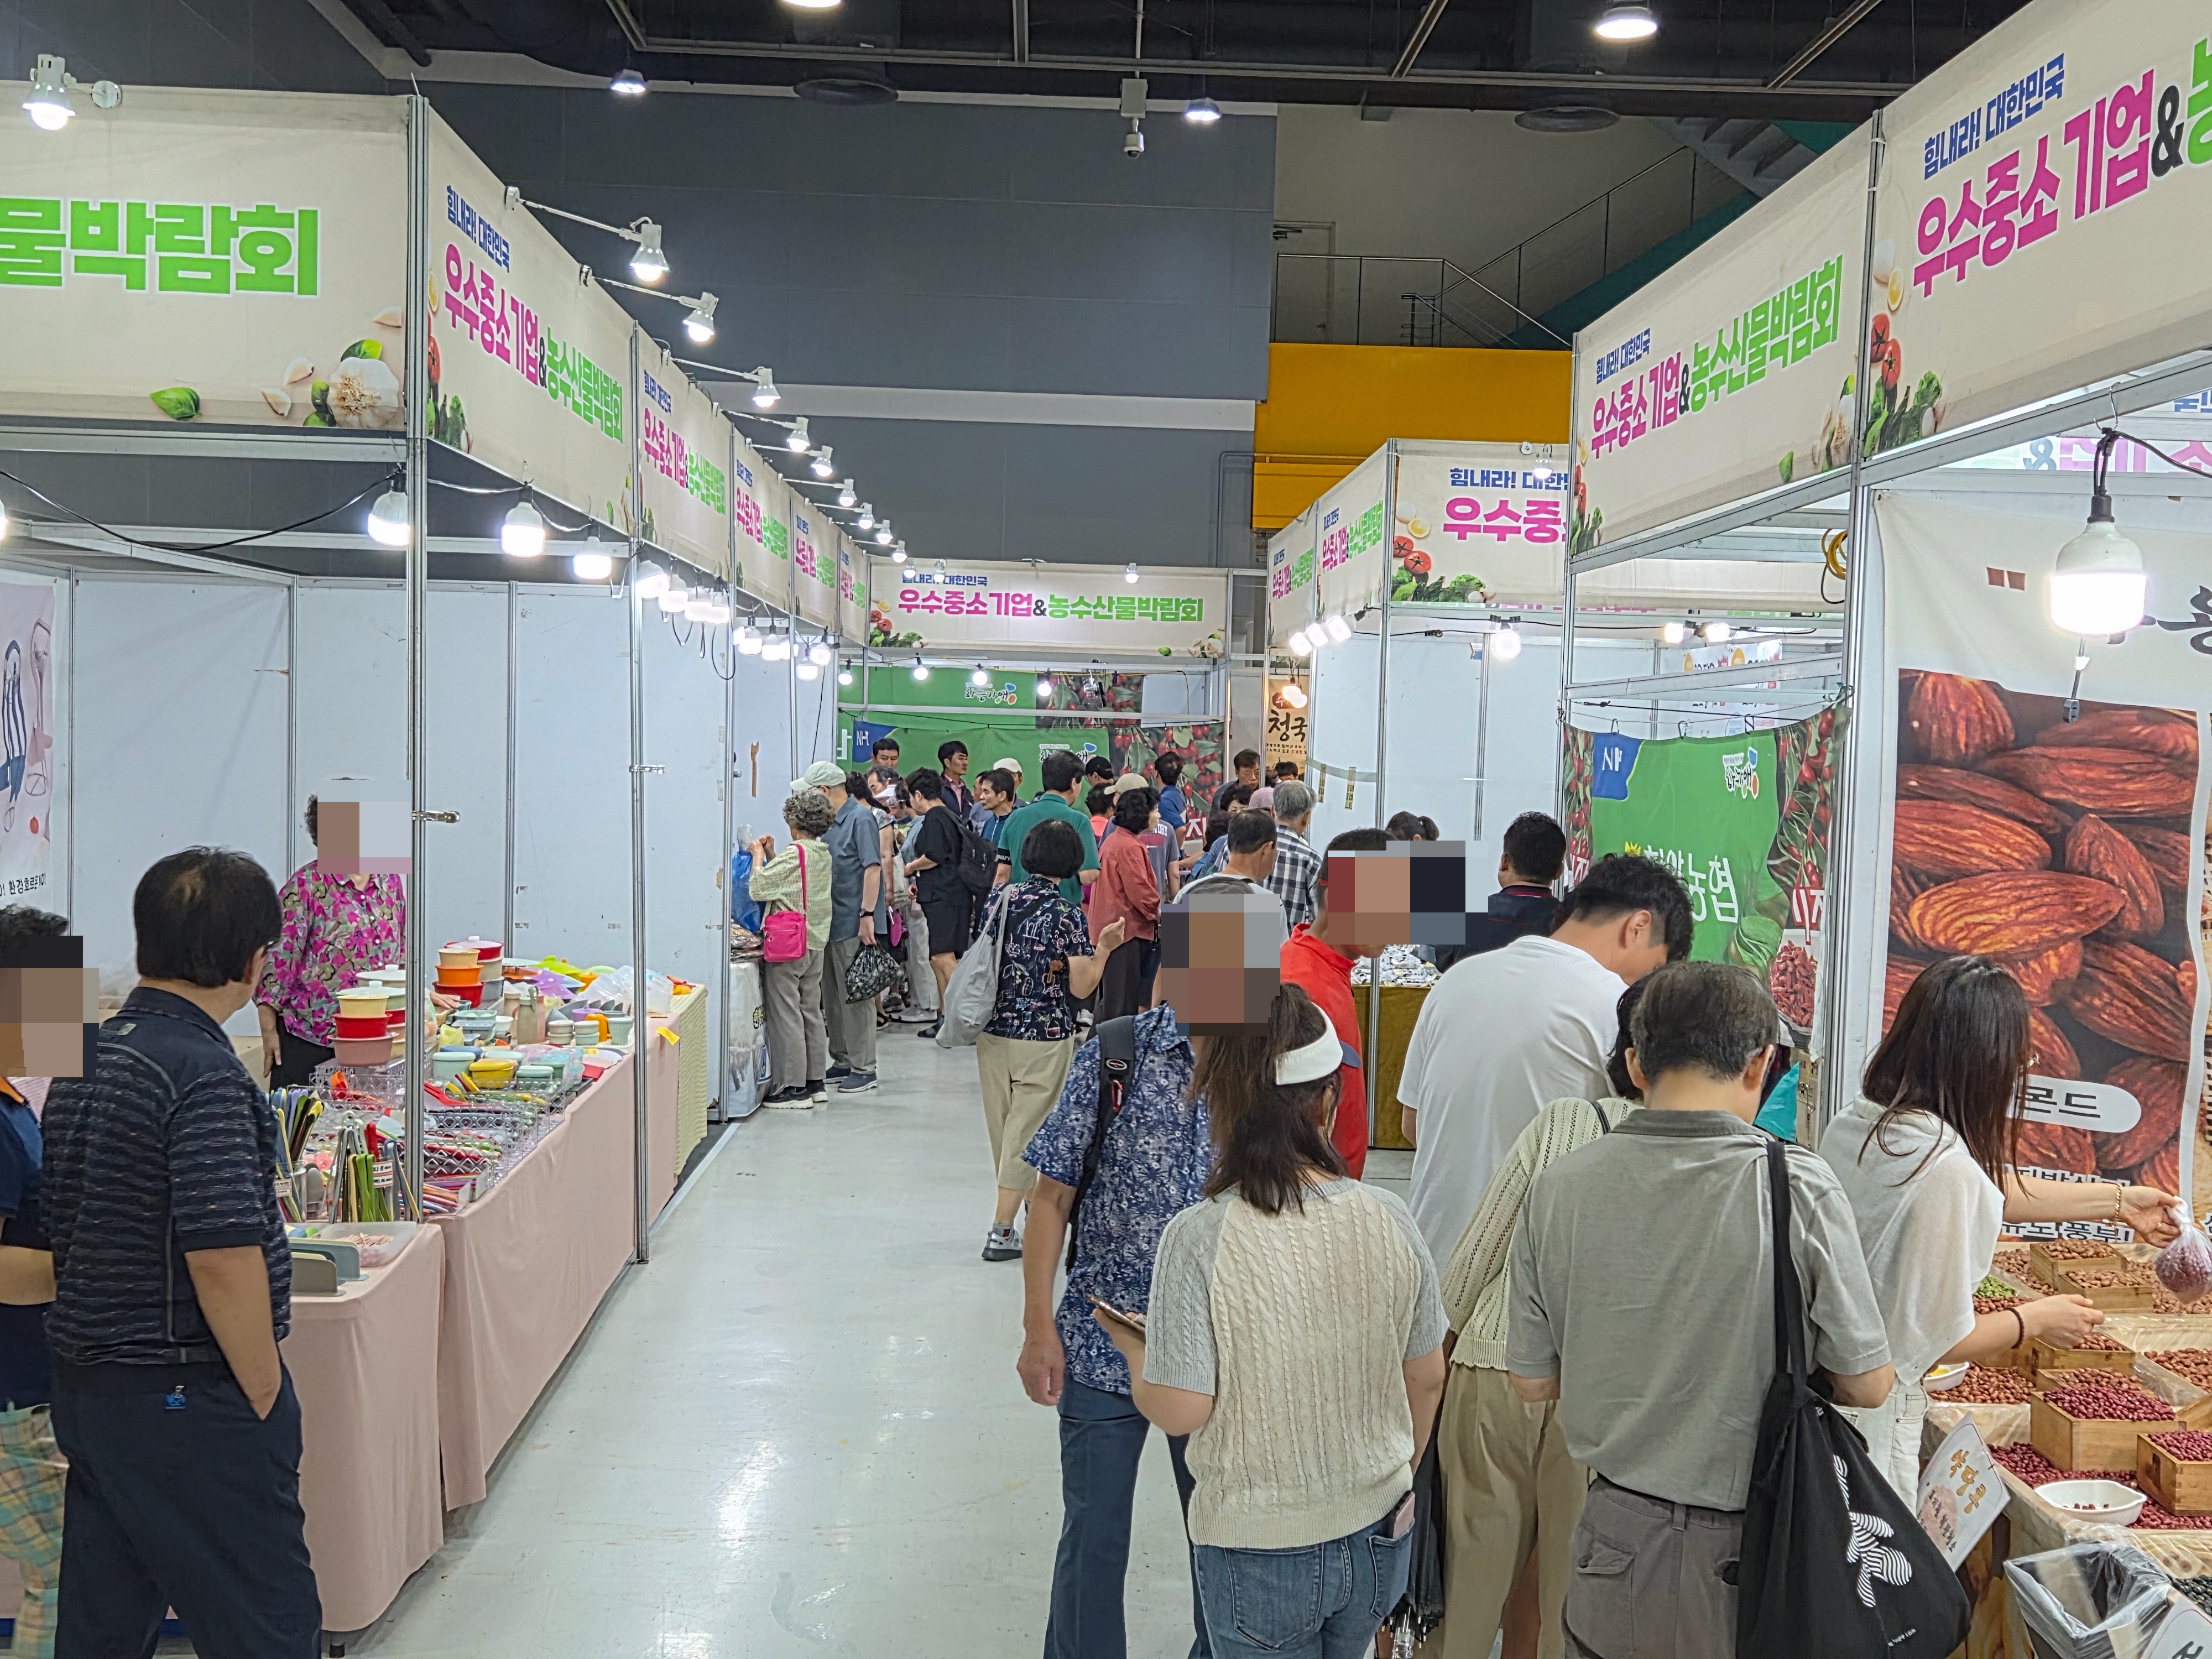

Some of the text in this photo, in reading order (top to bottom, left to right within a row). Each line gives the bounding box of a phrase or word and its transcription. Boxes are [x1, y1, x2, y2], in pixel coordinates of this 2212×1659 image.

[1924, 53, 2064, 180] 힘내라! 대한민국
[446, 185, 509, 273] 힘내라! 대한민국
[1597, 328, 1651, 385] 힘내라! 대한민국
[1450, 468, 1568, 491] 힘내라! 대한
[1443, 497, 1566, 544] 우수중
[942, 575, 988, 586] 대한민국
[857, 730, 869, 746] NH
[2016, 1084, 2101, 1118] 몬드
